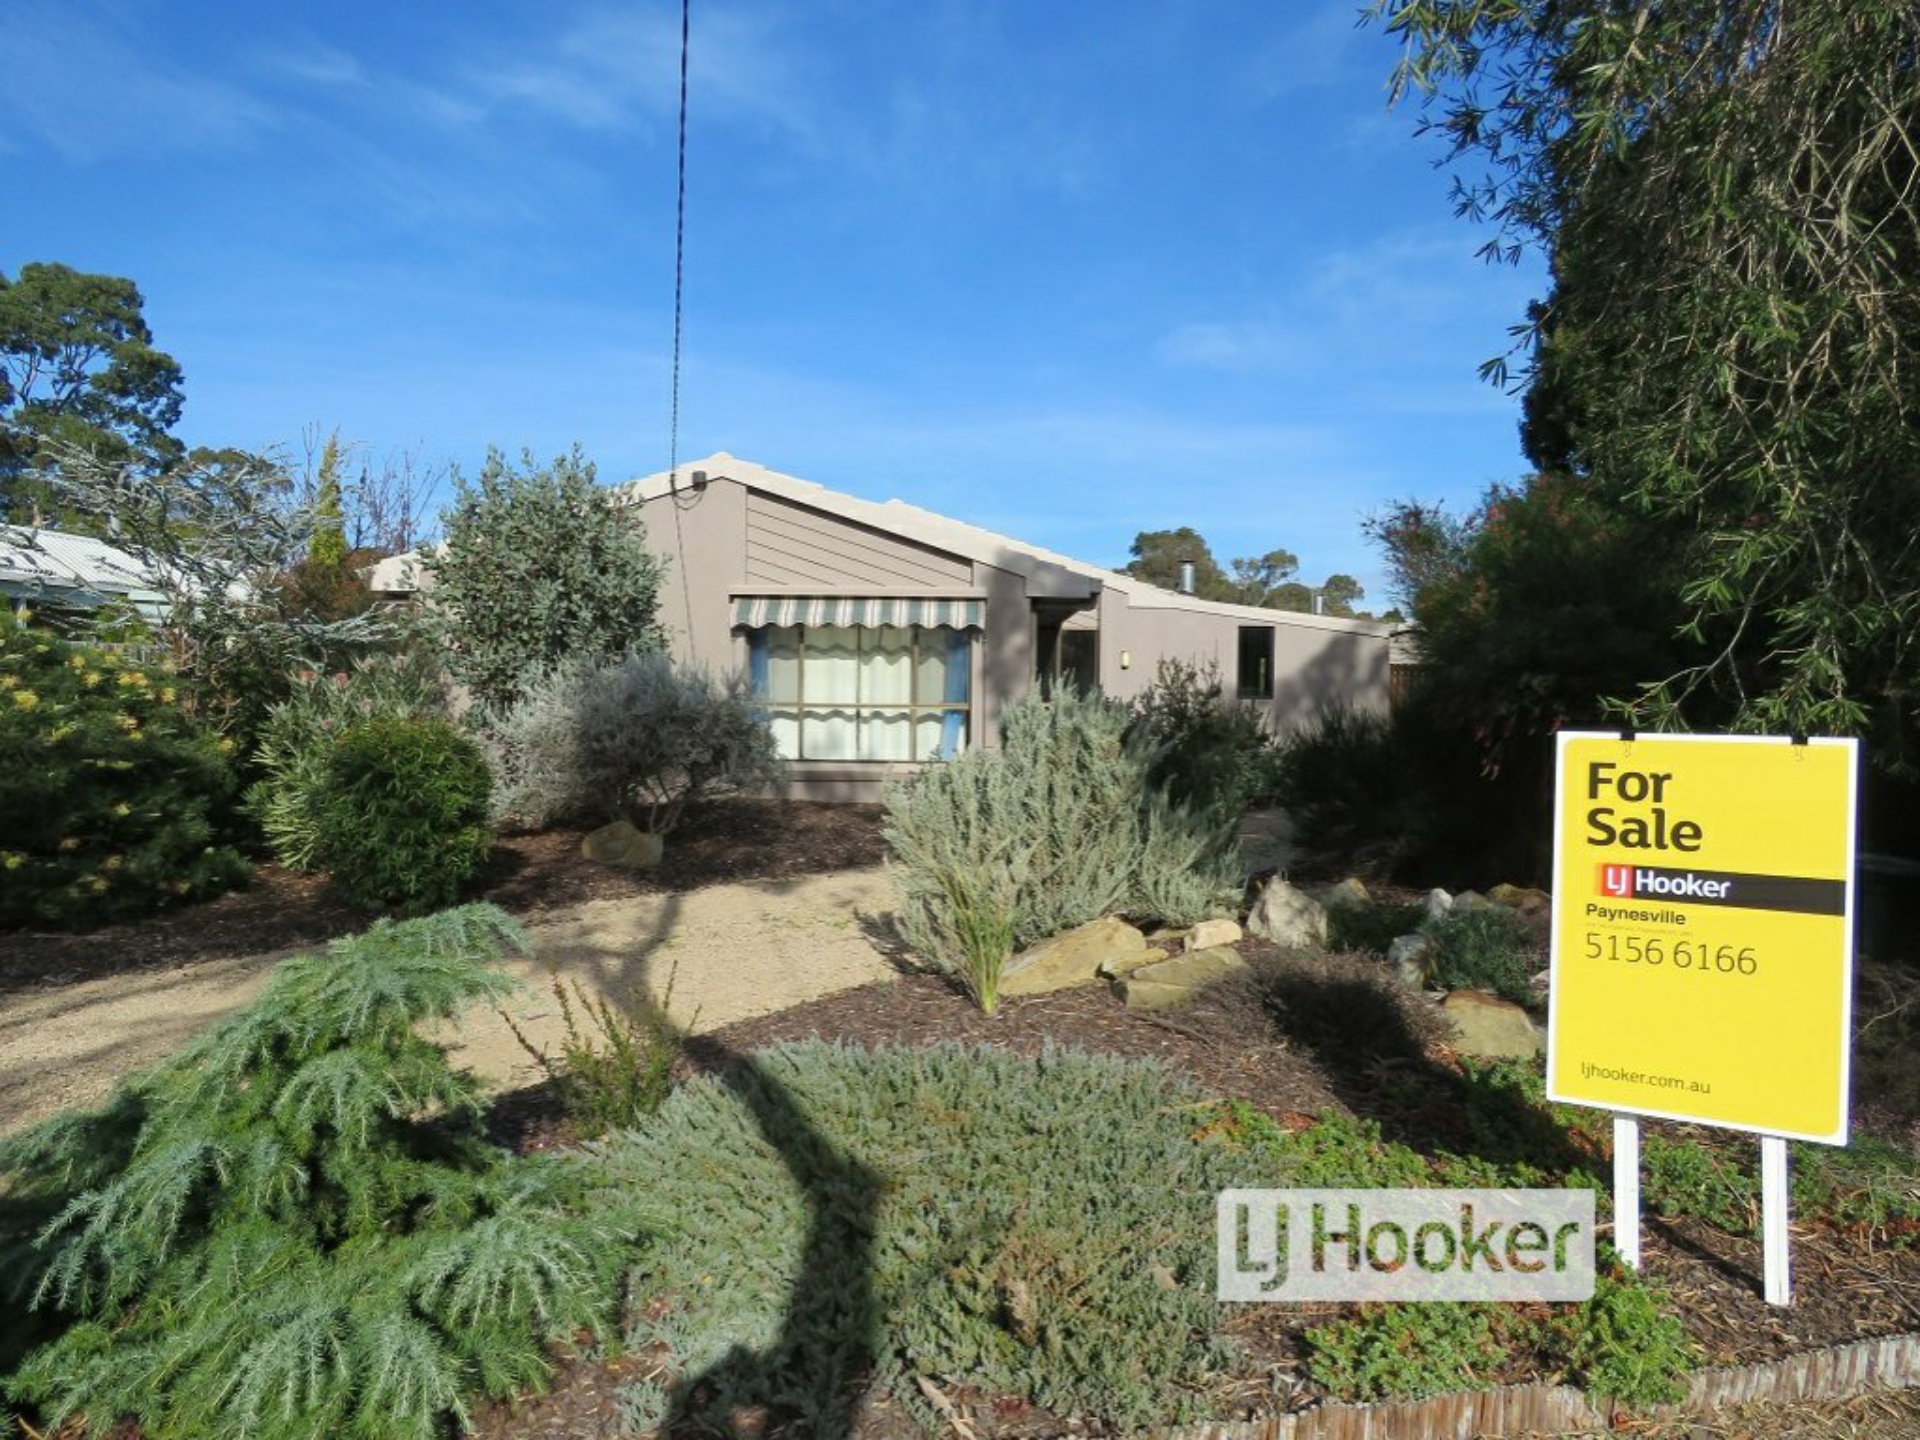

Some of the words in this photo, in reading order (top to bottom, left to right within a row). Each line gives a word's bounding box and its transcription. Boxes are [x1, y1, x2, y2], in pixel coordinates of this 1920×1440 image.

[1588, 762, 1672, 802] For
[1587, 808, 1703, 851] Sale
[1607, 868, 1627, 895] LJ
[1635, 870, 1731, 898] Hooker
[1586, 903, 1686, 925] Paynesville
[1585, 933, 1664, 964] 5156
[1673, 941, 1757, 975] 6166
[1581, 1061, 1711, 1095] ljhooker.com.au
